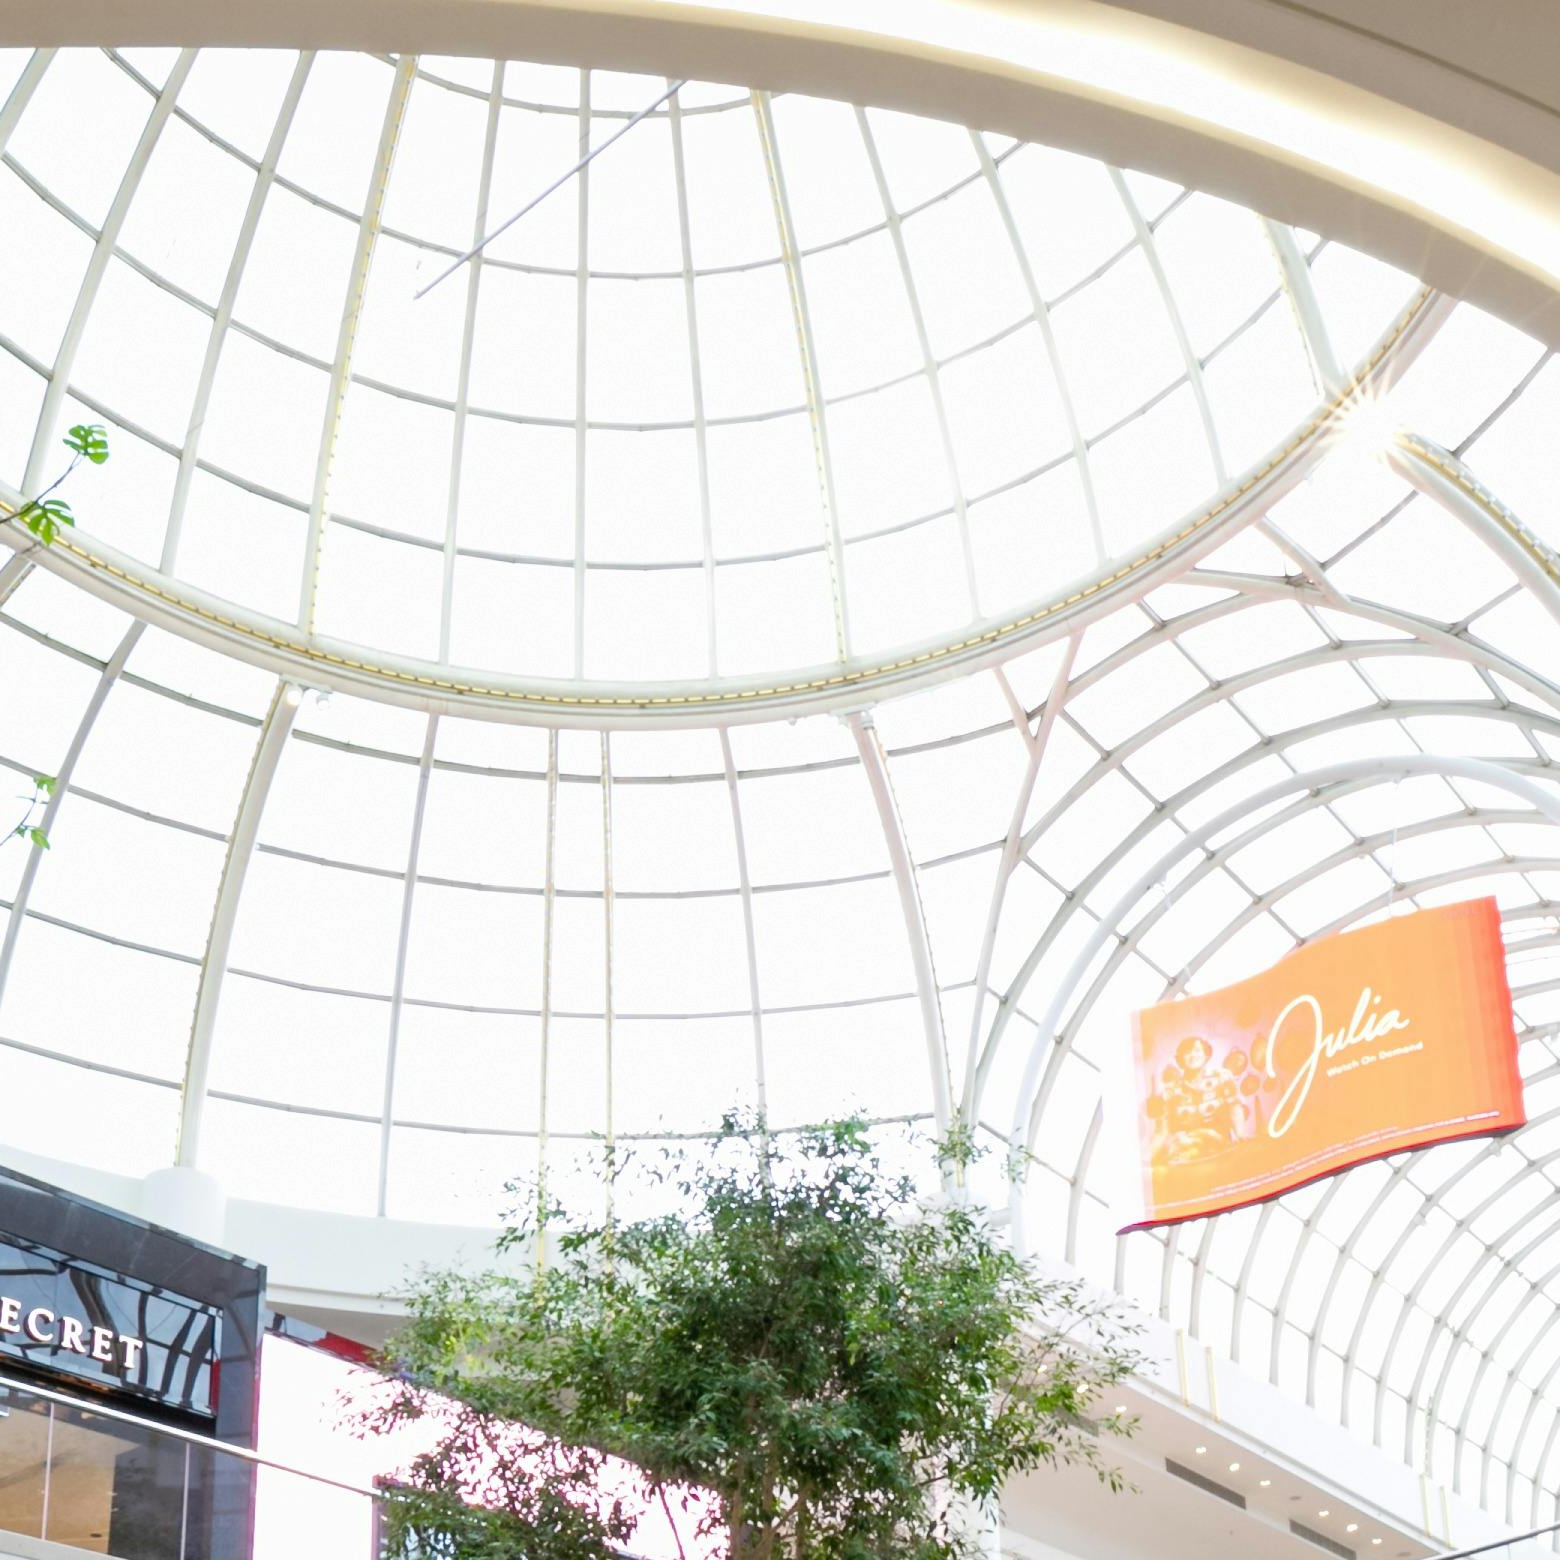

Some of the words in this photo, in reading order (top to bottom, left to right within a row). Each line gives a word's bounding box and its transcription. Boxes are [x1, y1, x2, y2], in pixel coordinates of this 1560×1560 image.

[1265, 987, 1411, 1138] Julia
[1326, 1060, 1359, 1077] Watch
[1361, 1055, 1377, 1065] On
[1379, 1041, 1424, 1060] Demand
